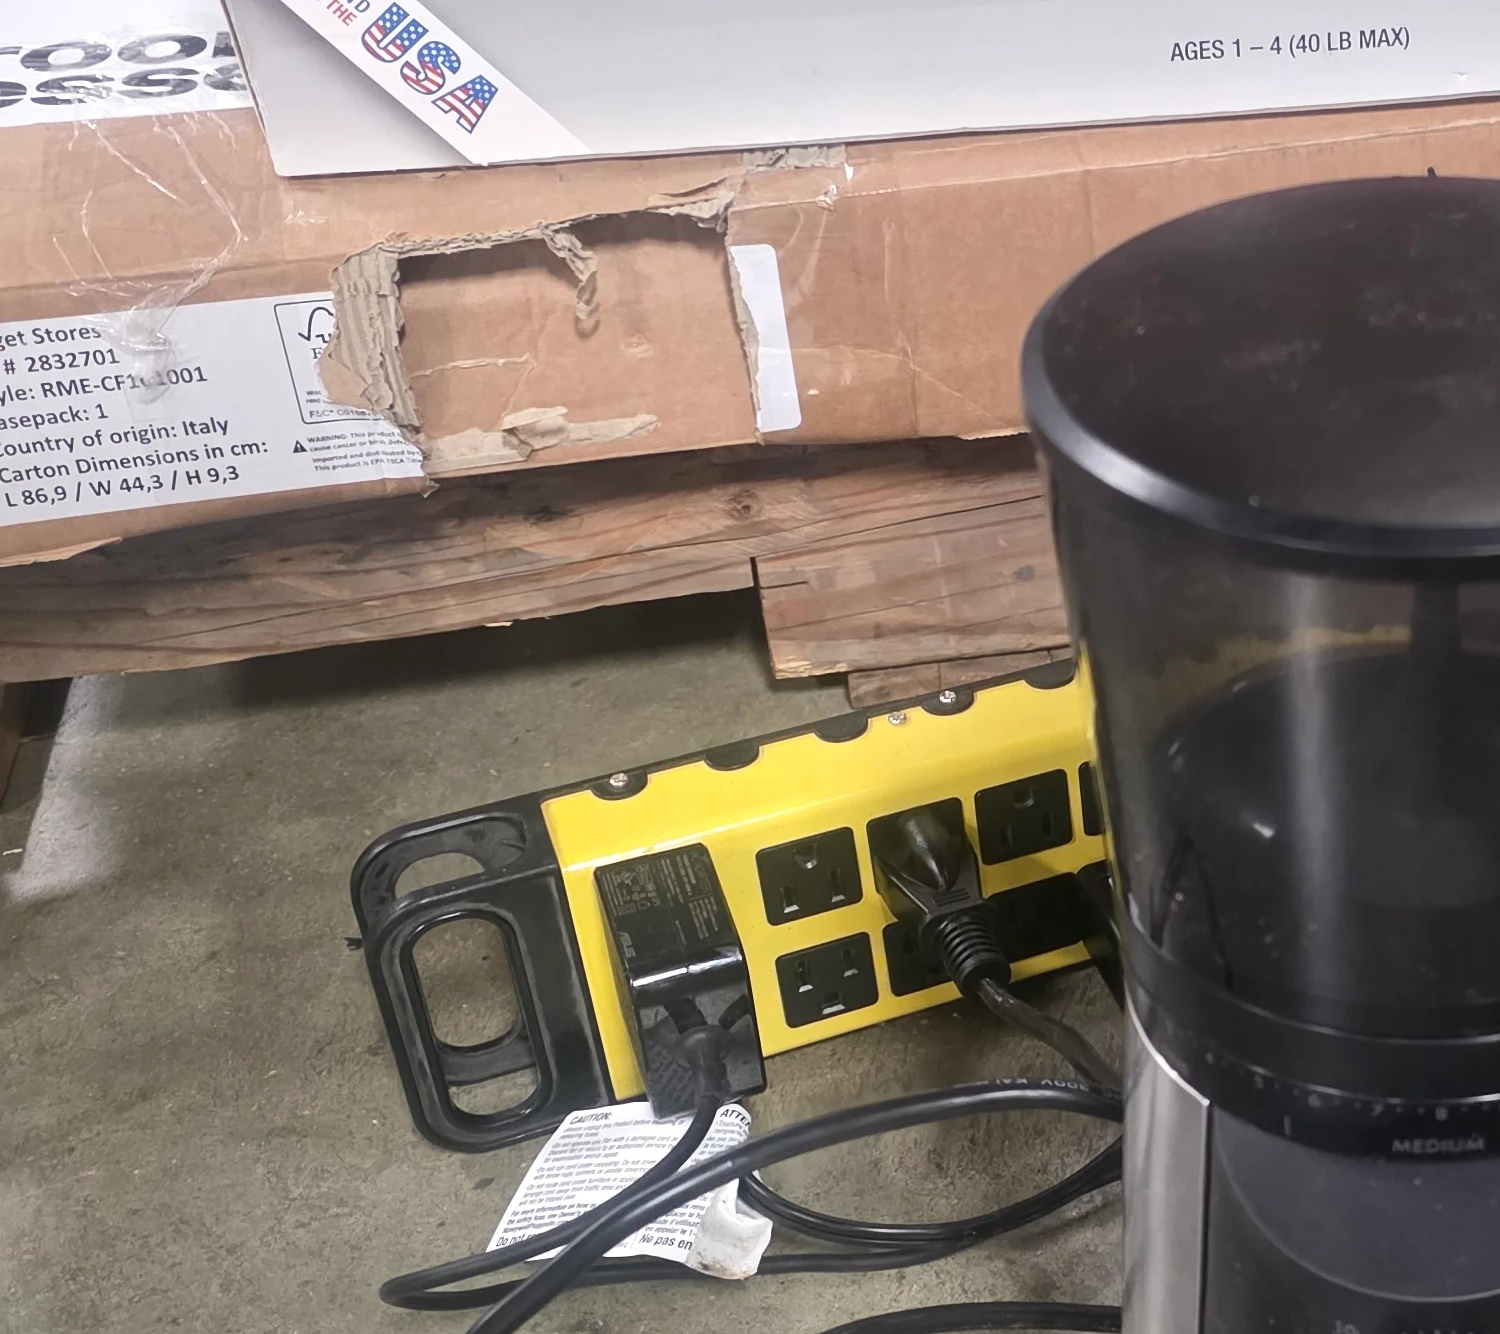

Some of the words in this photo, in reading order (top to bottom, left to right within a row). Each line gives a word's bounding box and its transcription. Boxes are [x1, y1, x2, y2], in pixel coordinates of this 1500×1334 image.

[1169, 39, 1226, 63] AGES
[1230, 37, 1242, 58] 1
[1268, 35, 1283, 56] 4
[1288, 34, 1320, 60] (40
[1326, 30, 1353, 53] LB
[1358, 25, 1412, 51] MAX)
[360, 1, 499, 135] USA
[33, 326, 101, 346] Stores
[3, 358, 16, 375] #
[24, 348, 121, 374] 2832701
[97, 403, 109, 421] 1
[82, 429, 103, 448] of
[109, 424, 178, 445] origin:
[183, 416, 229, 437] Italy
[0, 462, 70, 484] Carton
[75, 447, 200, 476] Dimensions
[203, 443, 225, 460] in
[230, 440, 269, 457] cm:
[4, 492, 19, 508] L
[21, 485, 68, 506] 86,9
[75, 481, 82, 503] /
[89, 479, 113, 498] W
[119, 474, 165, 494] 44,3
[171, 470, 178, 491] /
[185, 469, 203, 487] H
[207, 465, 241, 486] 9,3
[1391, 1136, 1487, 1153] MEDIUM
